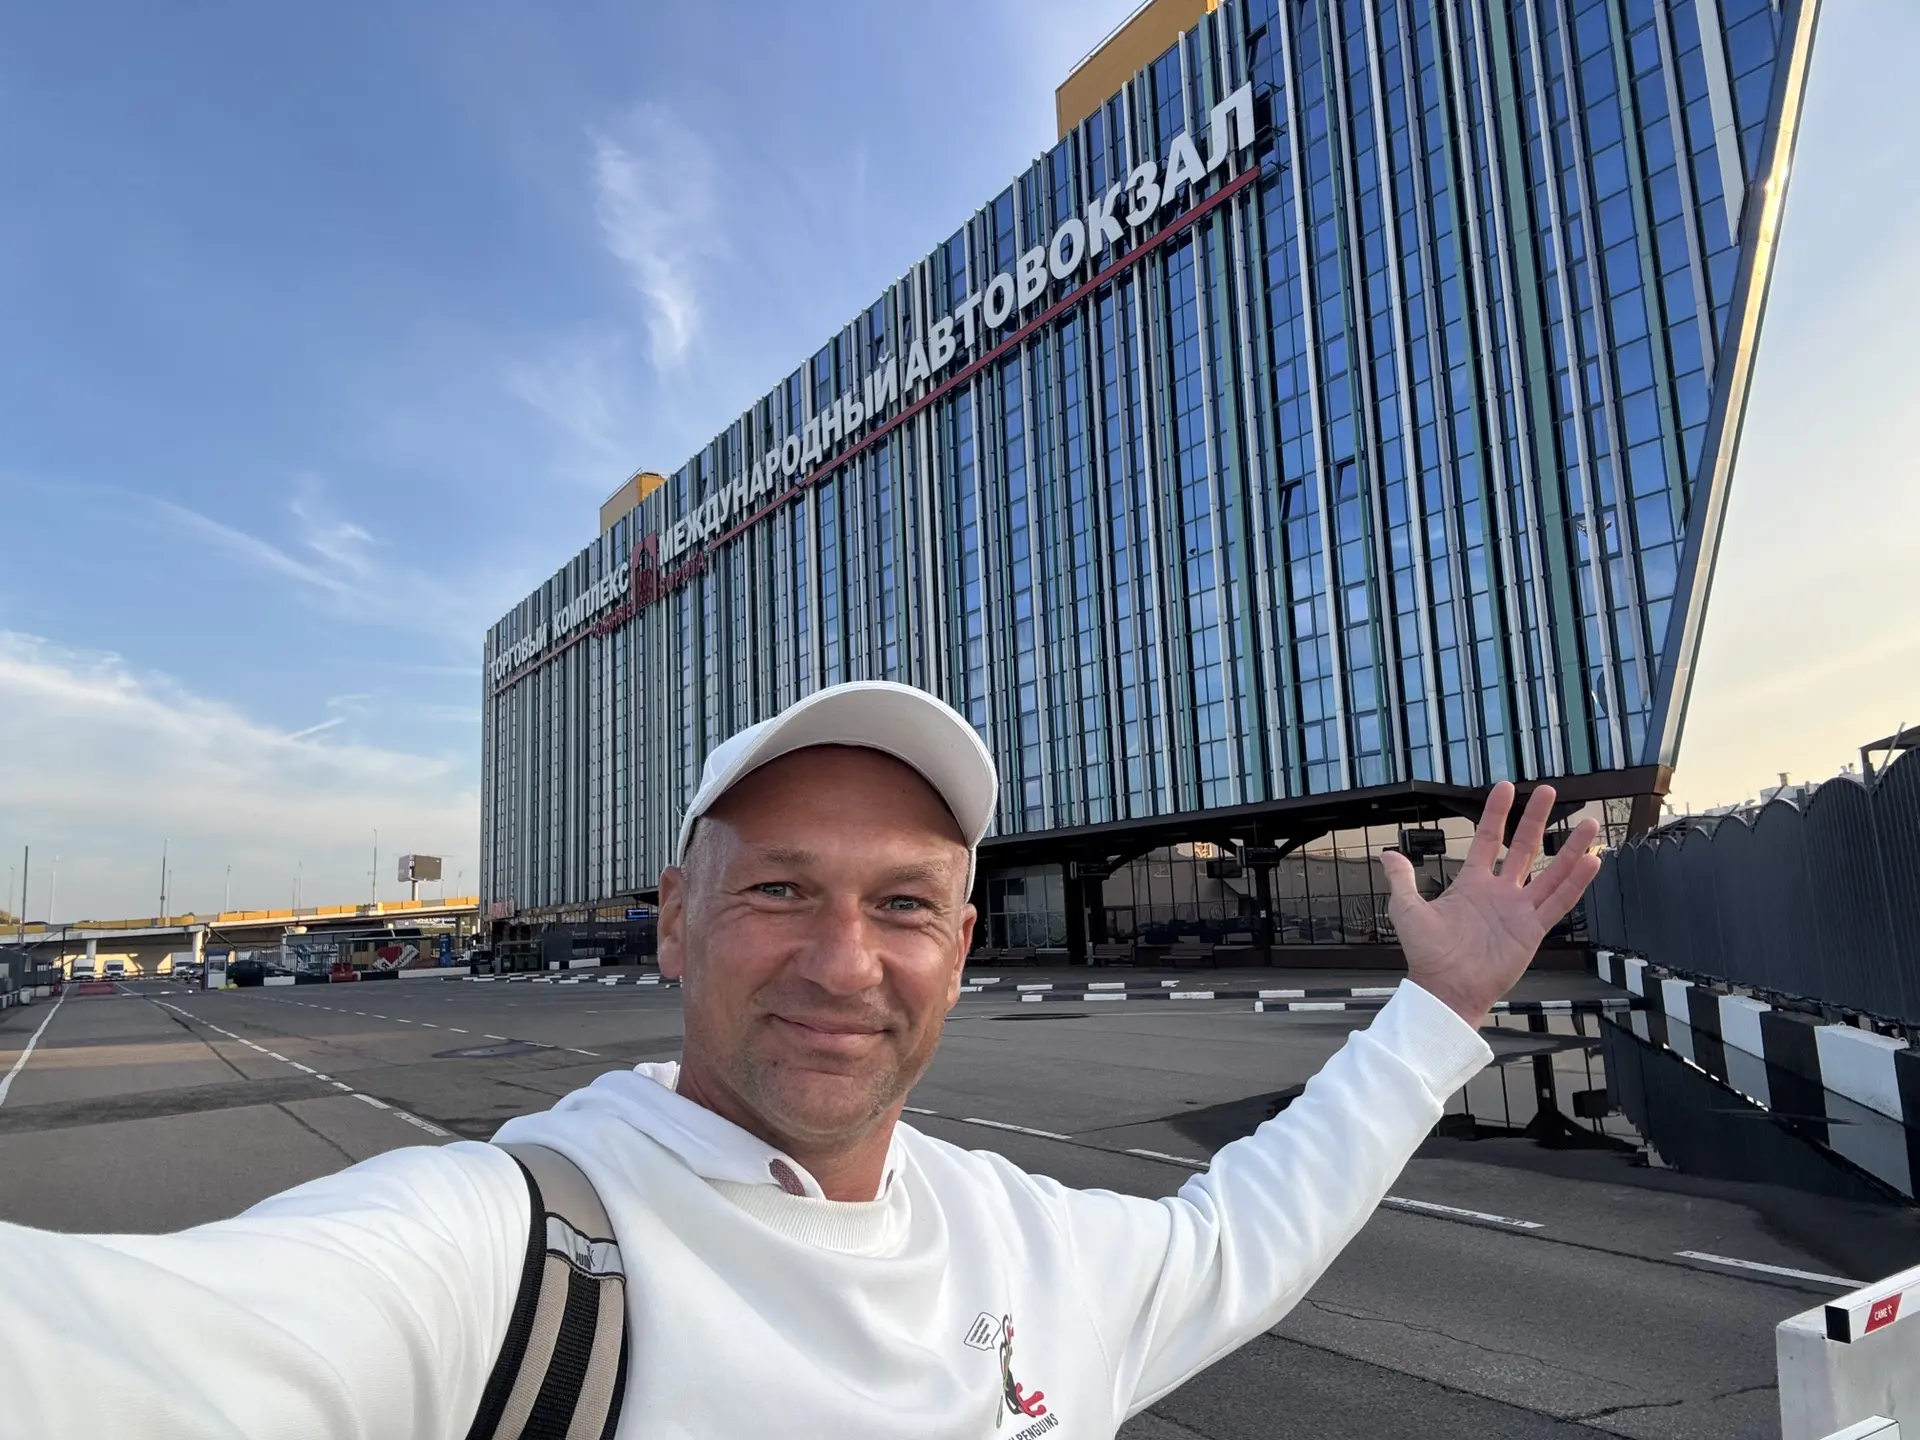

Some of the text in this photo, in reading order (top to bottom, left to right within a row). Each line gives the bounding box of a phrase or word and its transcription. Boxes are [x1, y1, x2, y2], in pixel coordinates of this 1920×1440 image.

[658, 80, 1256, 566] МЕЖДУНАРОДНЫЙ АВТОВОКЗАЛ
[490, 562, 629, 684] ТОРГОВЫЙ КОМПЛЕКС
[658, 551, 706, 599] ВОРОТА
